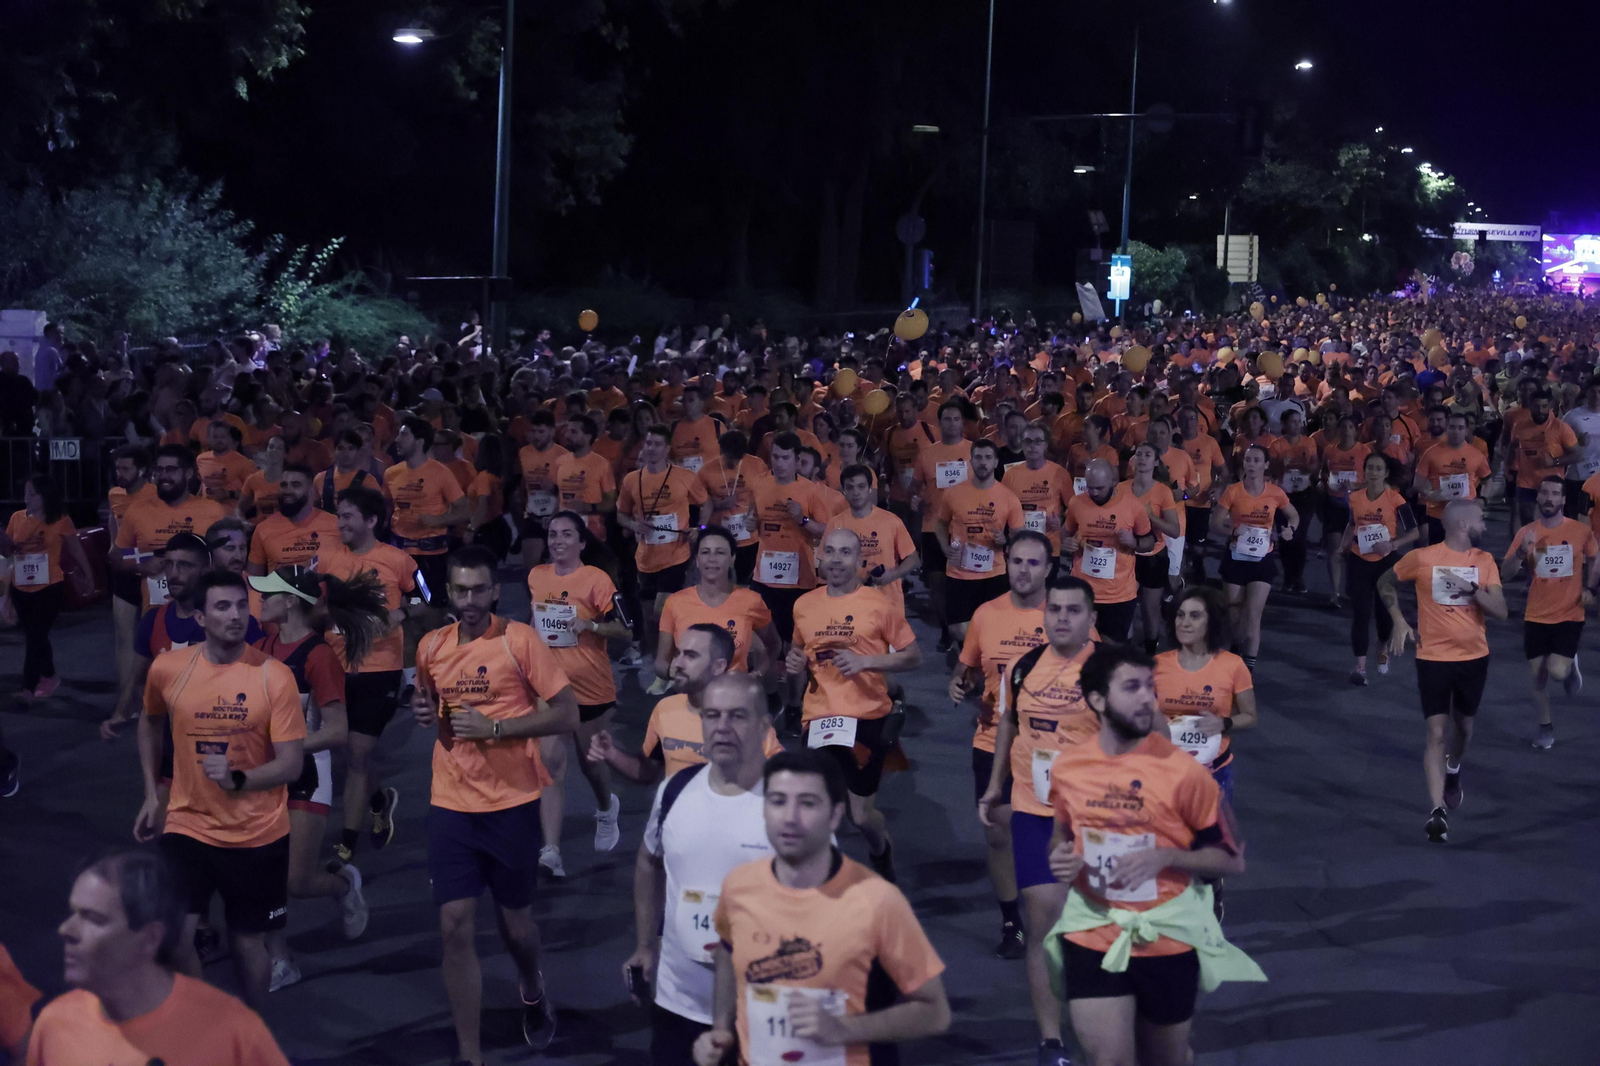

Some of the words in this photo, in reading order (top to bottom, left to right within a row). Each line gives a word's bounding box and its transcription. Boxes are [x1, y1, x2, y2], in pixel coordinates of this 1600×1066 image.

[51, 441, 77, 458] IMD
[1447, 482, 1465, 490] 14281
[1247, 536, 1264, 545] 4245
[1364, 533, 1383, 542] 12251
[1090, 556, 1107, 567] 3223
[1545, 556, 1564, 565] 5922
[23, 564, 40, 572] 5781
[769, 562, 791, 571] 14927
[442, 686, 470, 694] SEVILLA
[1165, 698, 1196, 706] SEVILLA
[194, 712, 227, 720] SEVILLA
[820, 718, 844, 730] 6283
[1180, 732, 1208, 745] 4295
